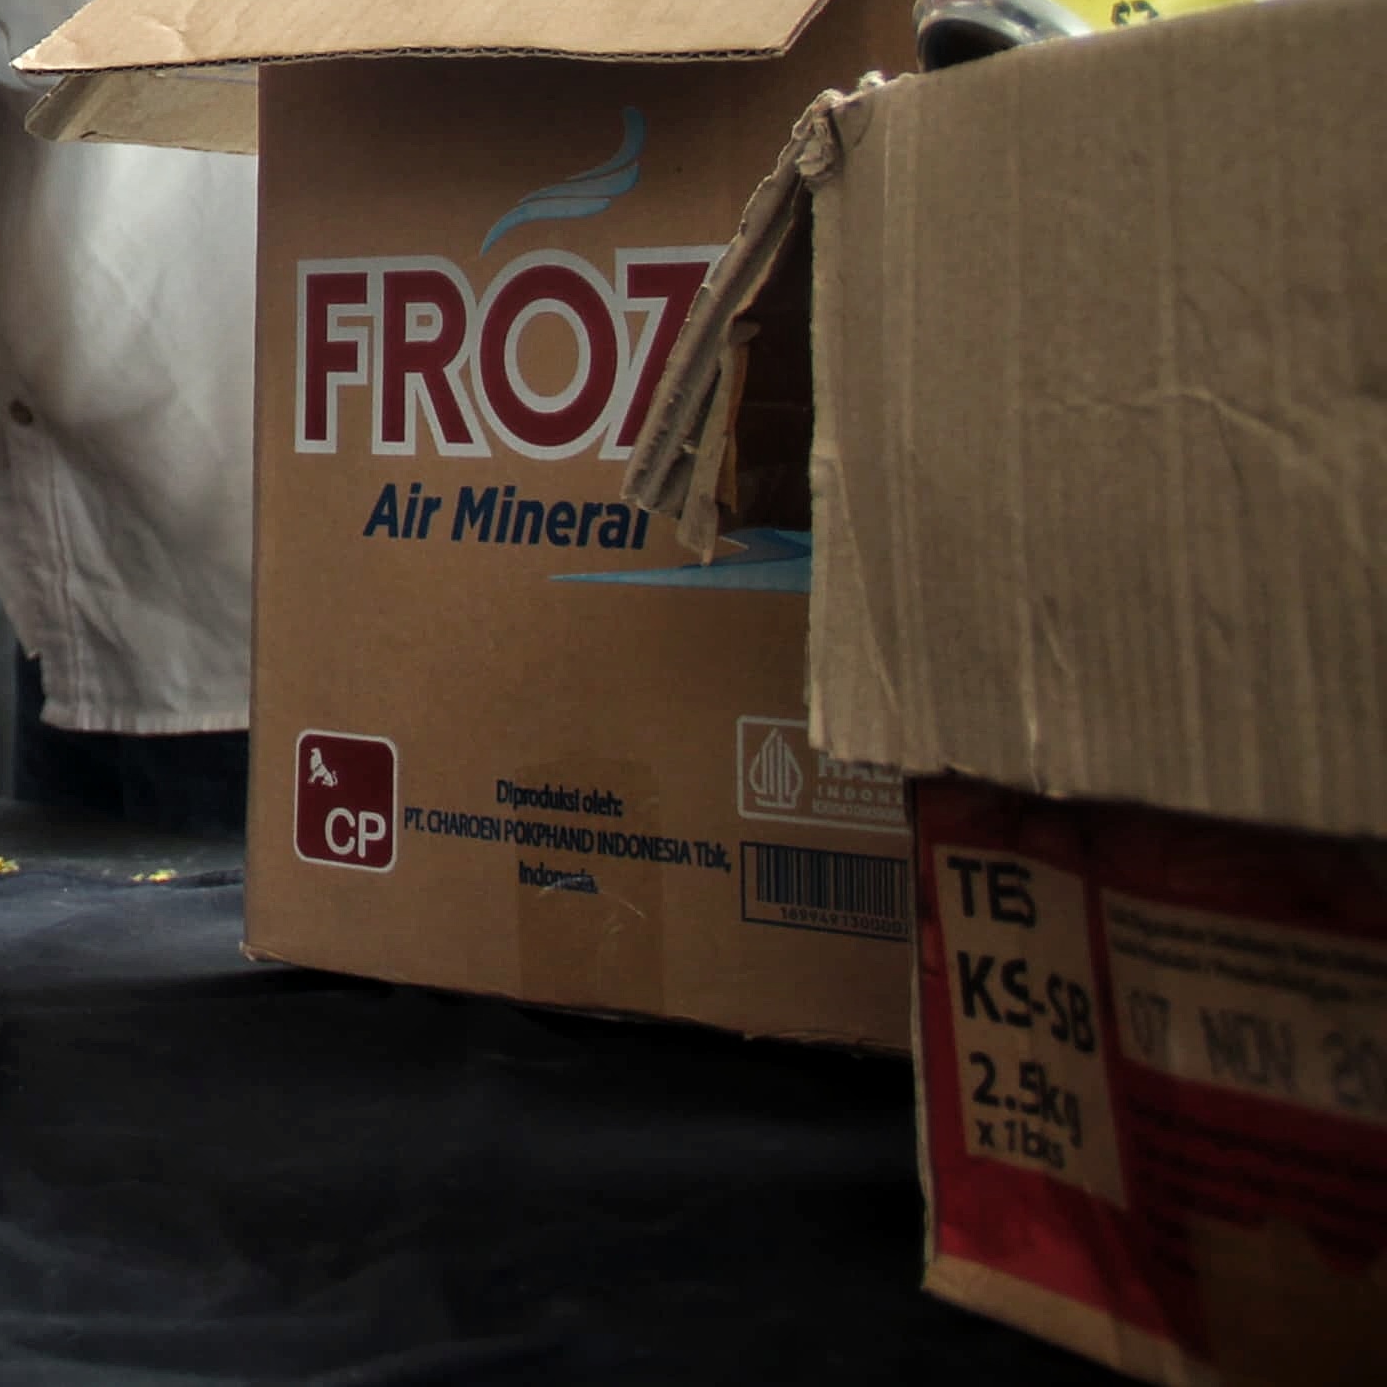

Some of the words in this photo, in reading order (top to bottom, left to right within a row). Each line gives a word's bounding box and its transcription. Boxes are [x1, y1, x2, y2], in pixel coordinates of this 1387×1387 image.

[362, 482, 442, 540] Air
[496, 778, 579, 812] Diproduksi
[324, 807, 387, 859] CP
[403, 806, 425, 832] PT.
[427, 809, 502, 843] CHAROEN
[503, 819, 595, 855] POKPHAND
[597, 831, 692, 866] INDONESIA
